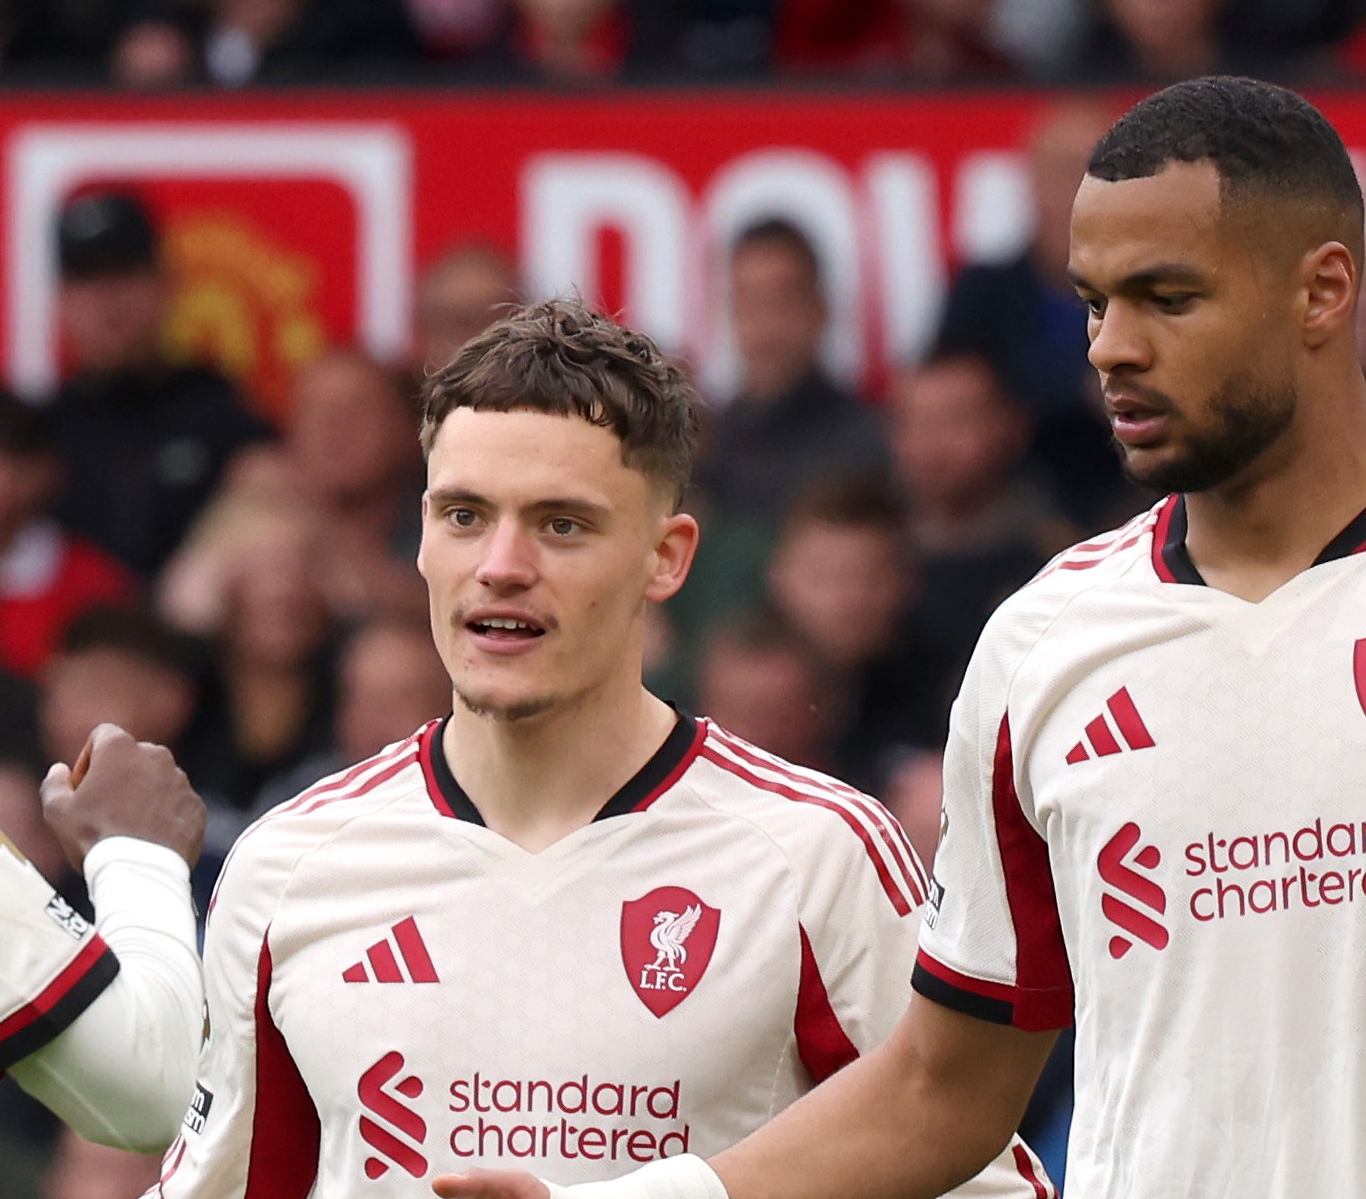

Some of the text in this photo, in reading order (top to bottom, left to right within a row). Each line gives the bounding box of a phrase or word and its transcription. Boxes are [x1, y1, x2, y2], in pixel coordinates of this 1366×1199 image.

[640, 970, 687, 991] L.F.C.
[449, 1072, 680, 1119] standard
[449, 1117, 690, 1162] chartered
